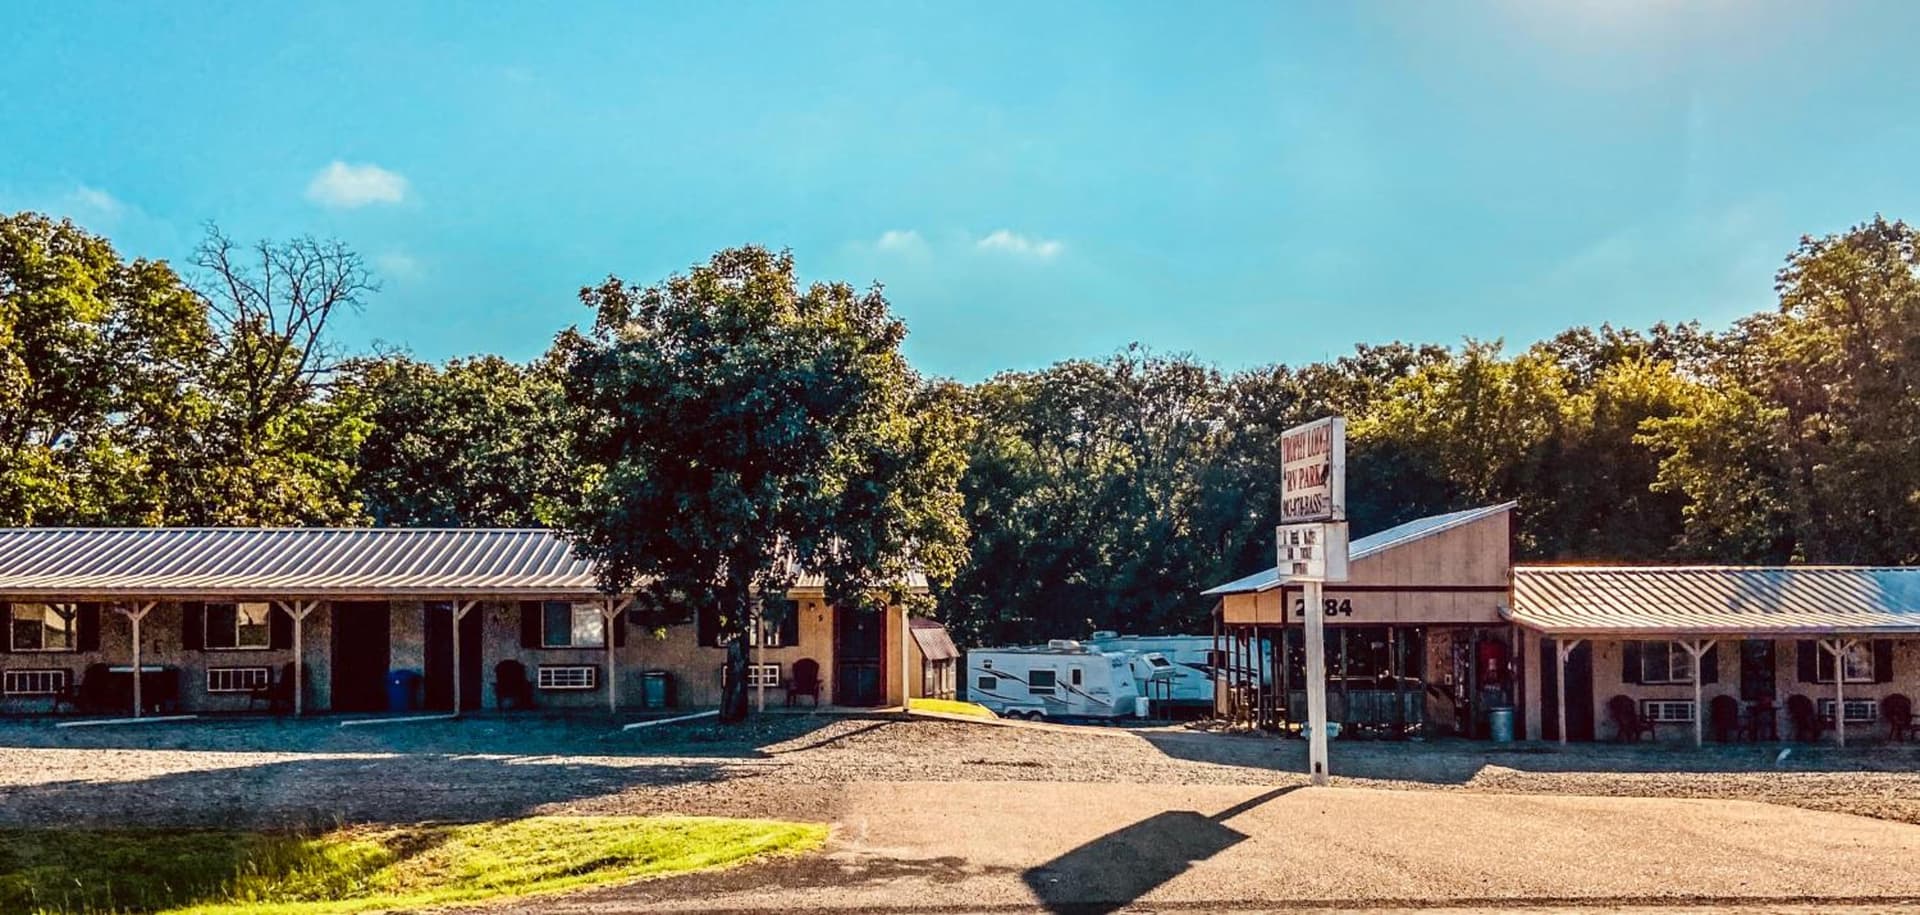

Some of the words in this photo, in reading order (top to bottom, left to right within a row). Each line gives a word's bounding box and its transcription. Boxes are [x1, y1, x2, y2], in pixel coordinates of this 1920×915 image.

[1287, 470, 1297, 492] RV
[1299, 464, 1321, 490] PARK
[1295, 598, 1353, 617] 284
